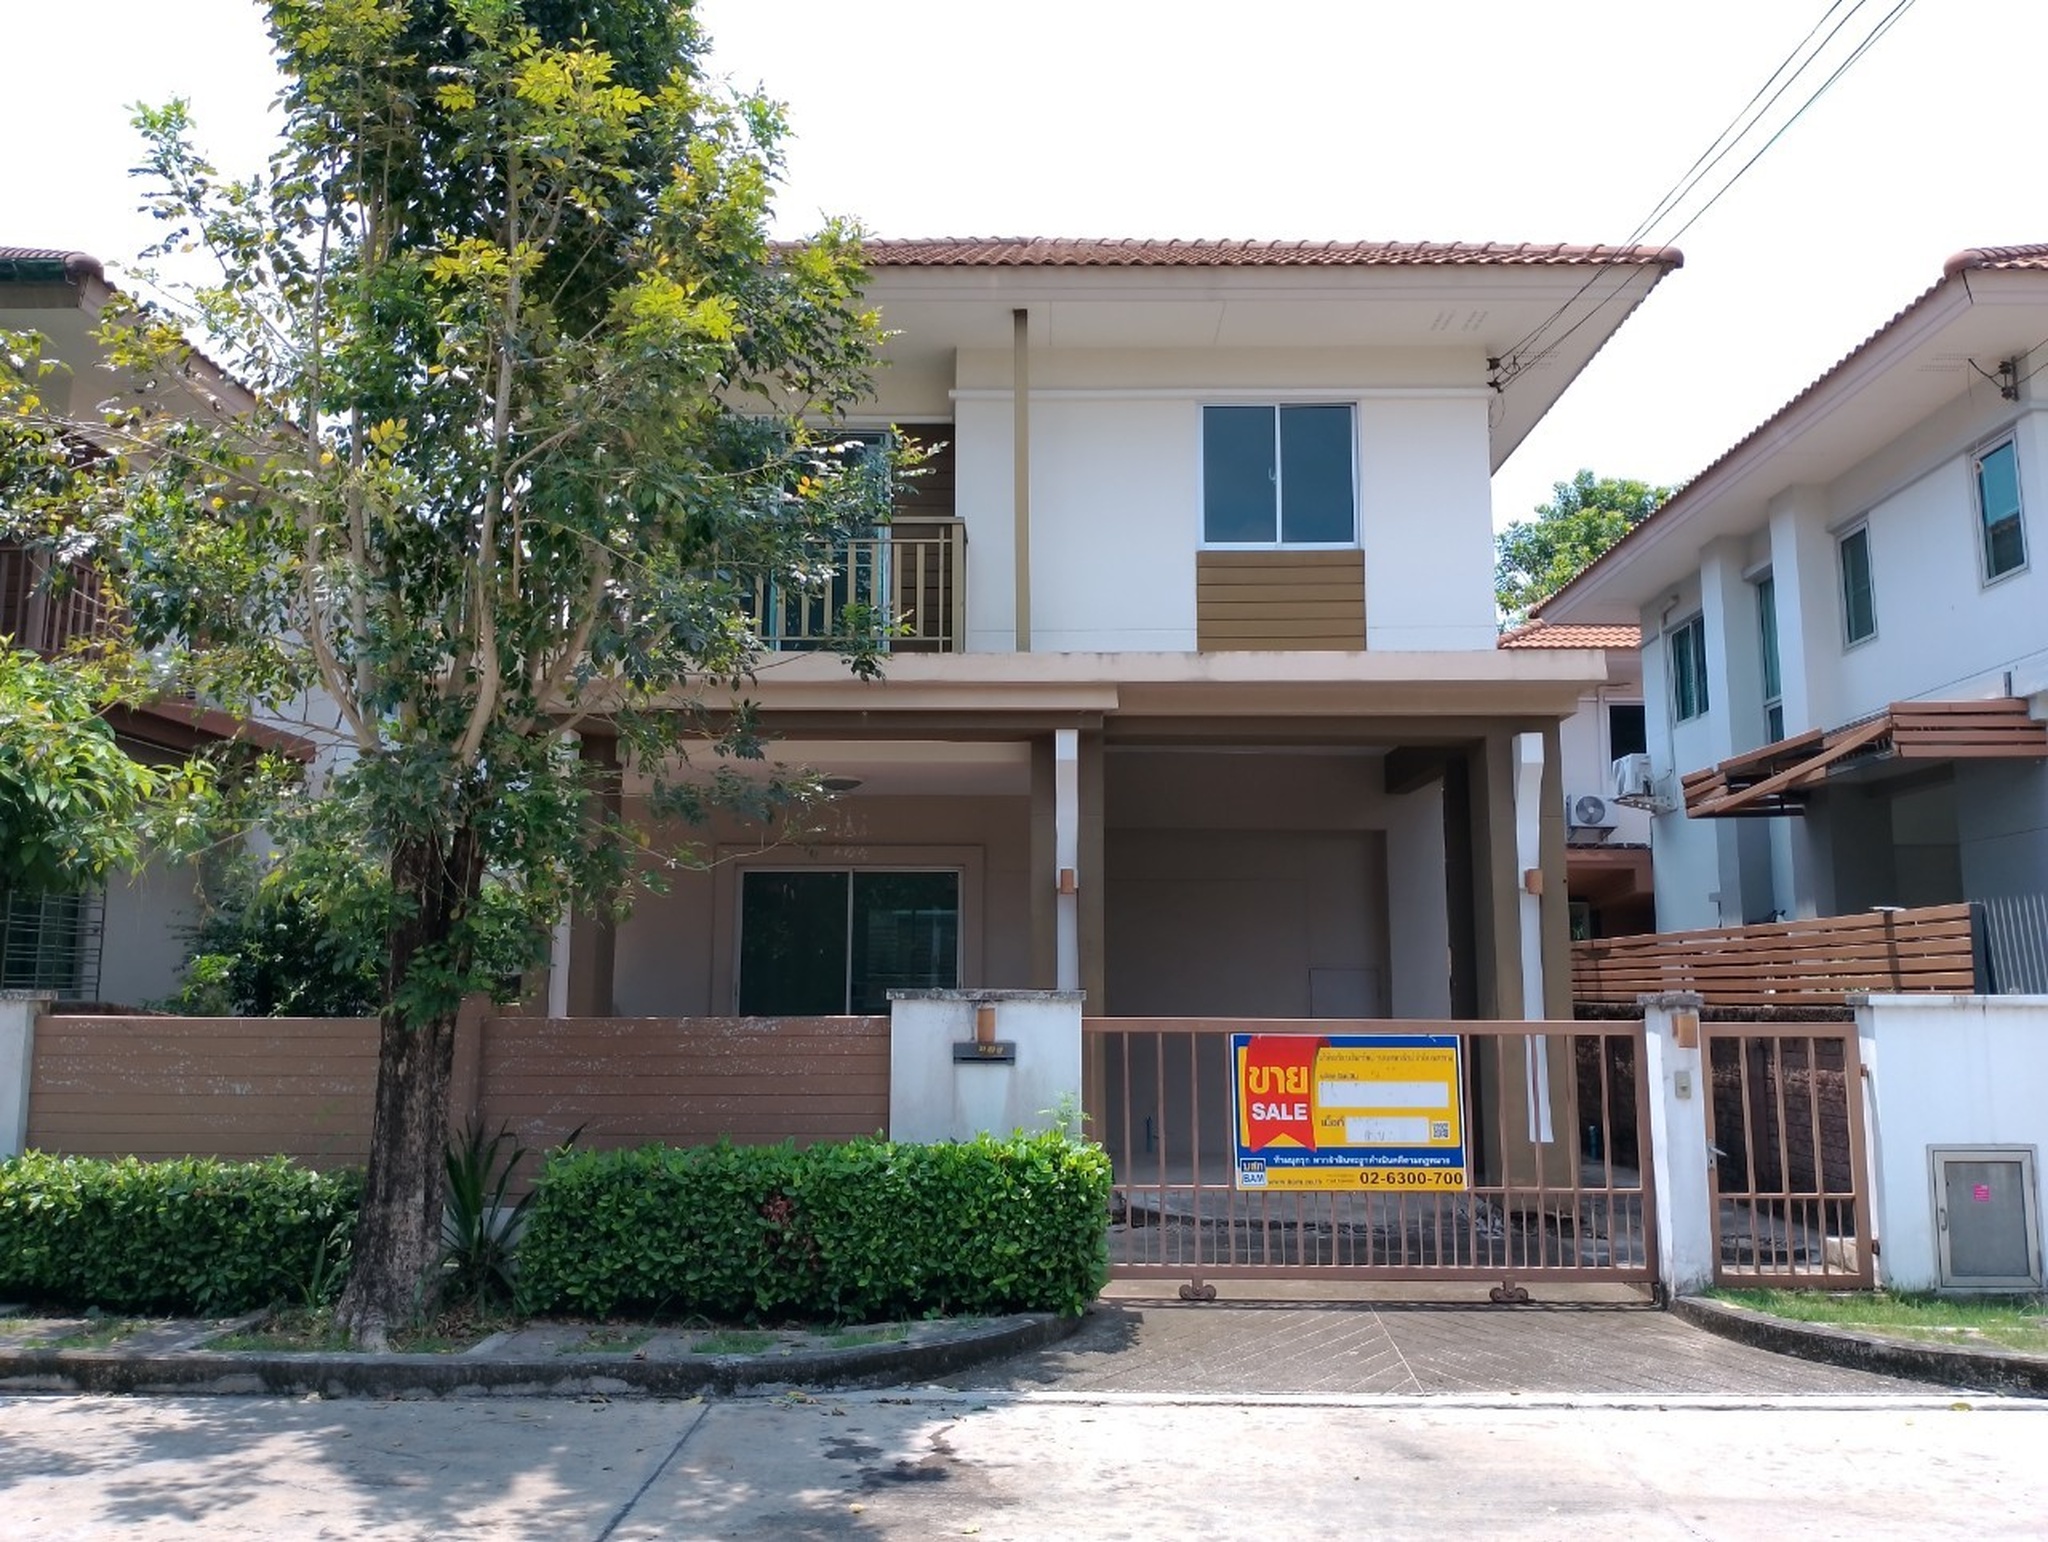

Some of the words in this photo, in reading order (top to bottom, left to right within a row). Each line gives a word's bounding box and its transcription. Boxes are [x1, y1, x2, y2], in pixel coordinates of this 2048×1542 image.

[1249, 1066, 1309, 1094] ขาย
[1252, 1103, 1308, 1121] SALE
[1243, 1173, 1264, 1183] BAM
[1360, 1172, 1463, 1185] 02-6300-700
